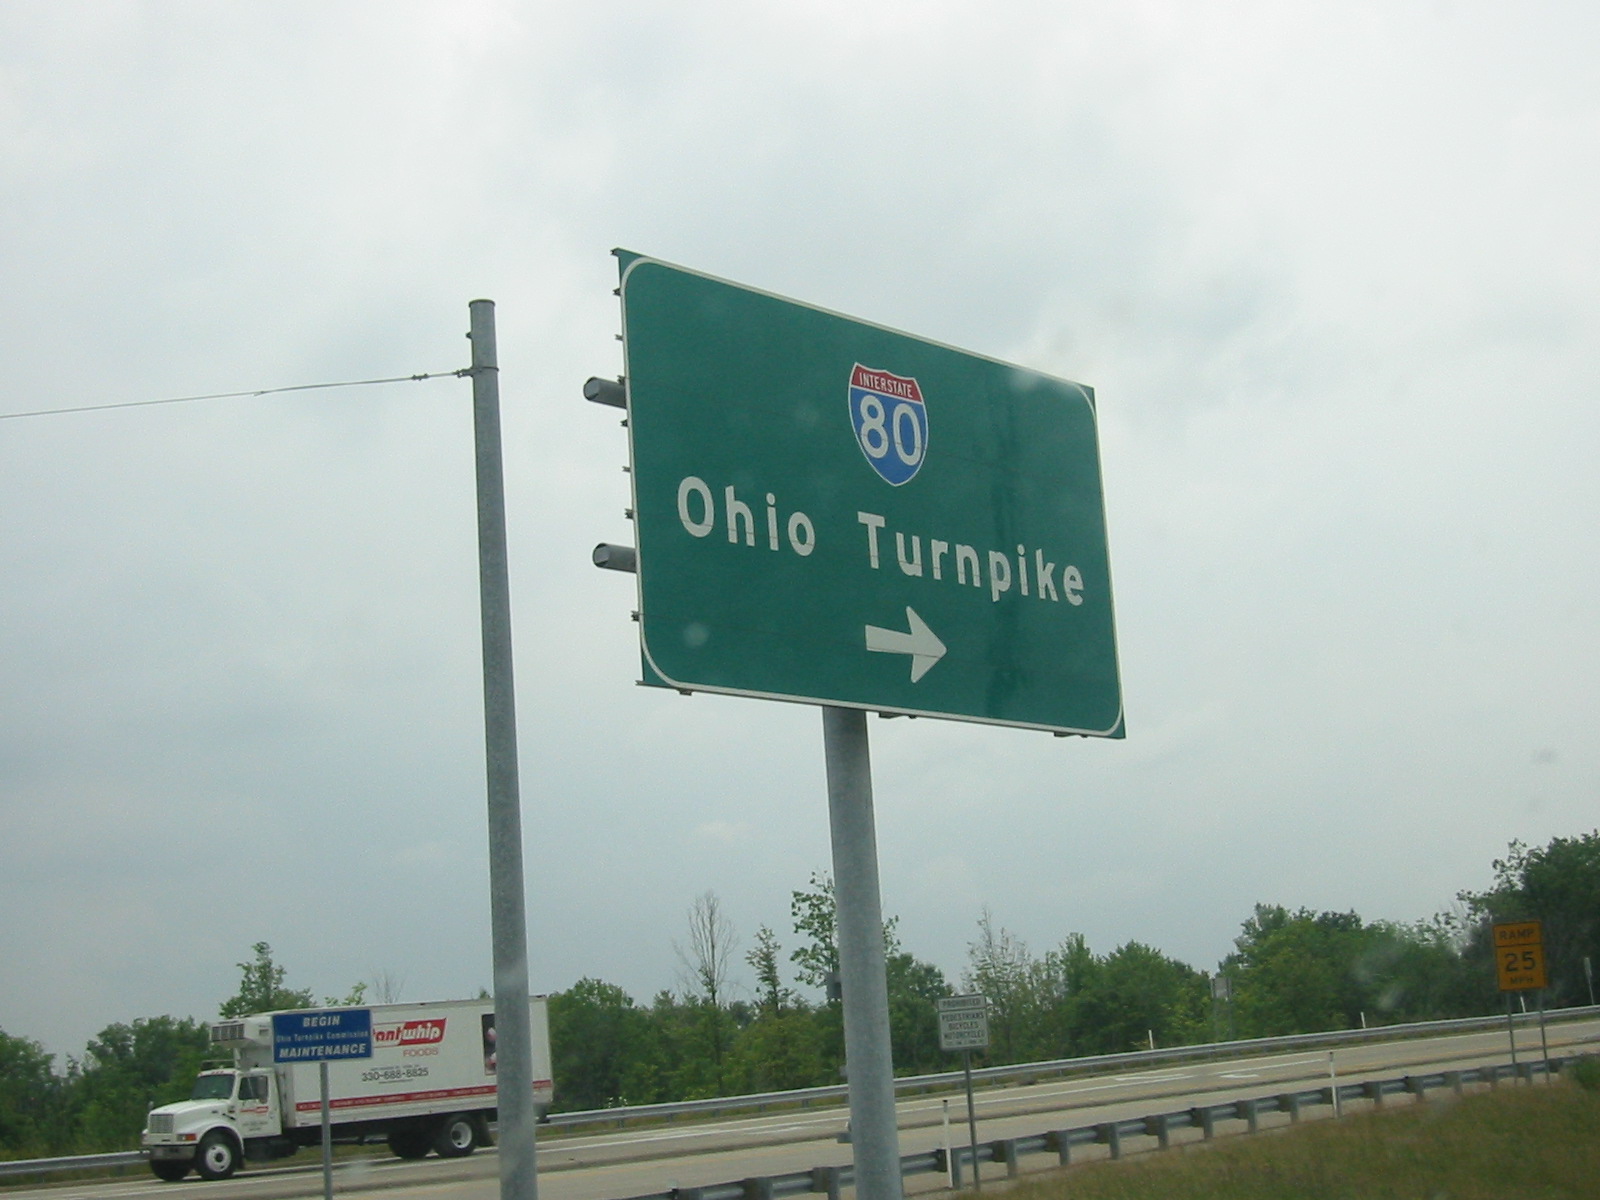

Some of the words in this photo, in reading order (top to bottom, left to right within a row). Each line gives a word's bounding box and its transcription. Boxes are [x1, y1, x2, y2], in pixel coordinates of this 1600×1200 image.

[859, 372, 913, 399] INTERSTATE
[860, 394, 922, 467] 80
[677, 476, 816, 557] Ohio
[857, 511, 1085, 606] Turnpike
[1500, 928, 1534, 940] RAMP
[1505, 951, 1536, 972] 25
[303, 1015, 340, 1028] BEGIN
[278, 1043, 367, 1059] MAINTENANCE
[403, 1047, 439, 1057] FOODS
